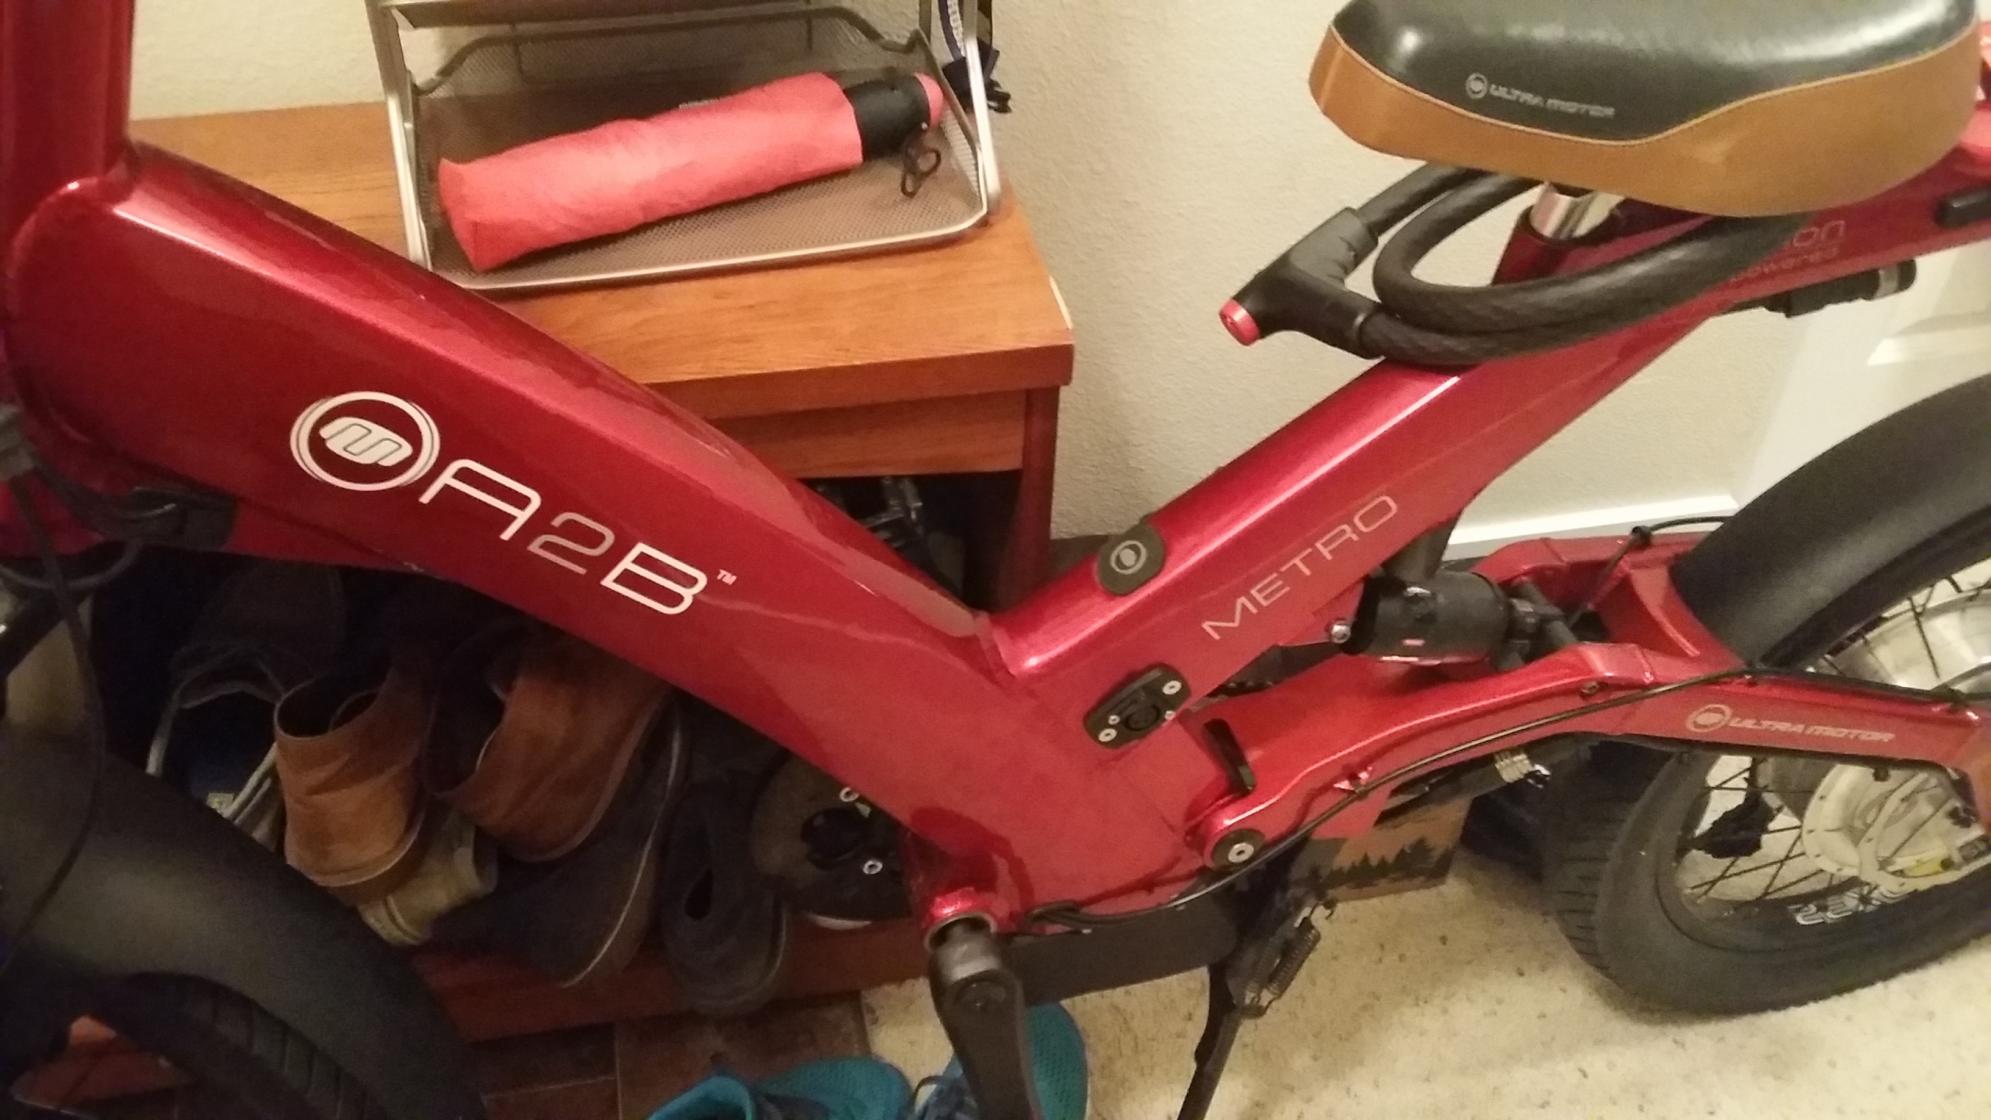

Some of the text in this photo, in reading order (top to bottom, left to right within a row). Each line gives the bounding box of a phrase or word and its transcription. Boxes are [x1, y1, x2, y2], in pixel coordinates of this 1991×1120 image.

[418, 458, 708, 615] A2B
[1201, 495, 1398, 640] METRO
[1728, 716, 1896, 743] ULTRA MOTOR
